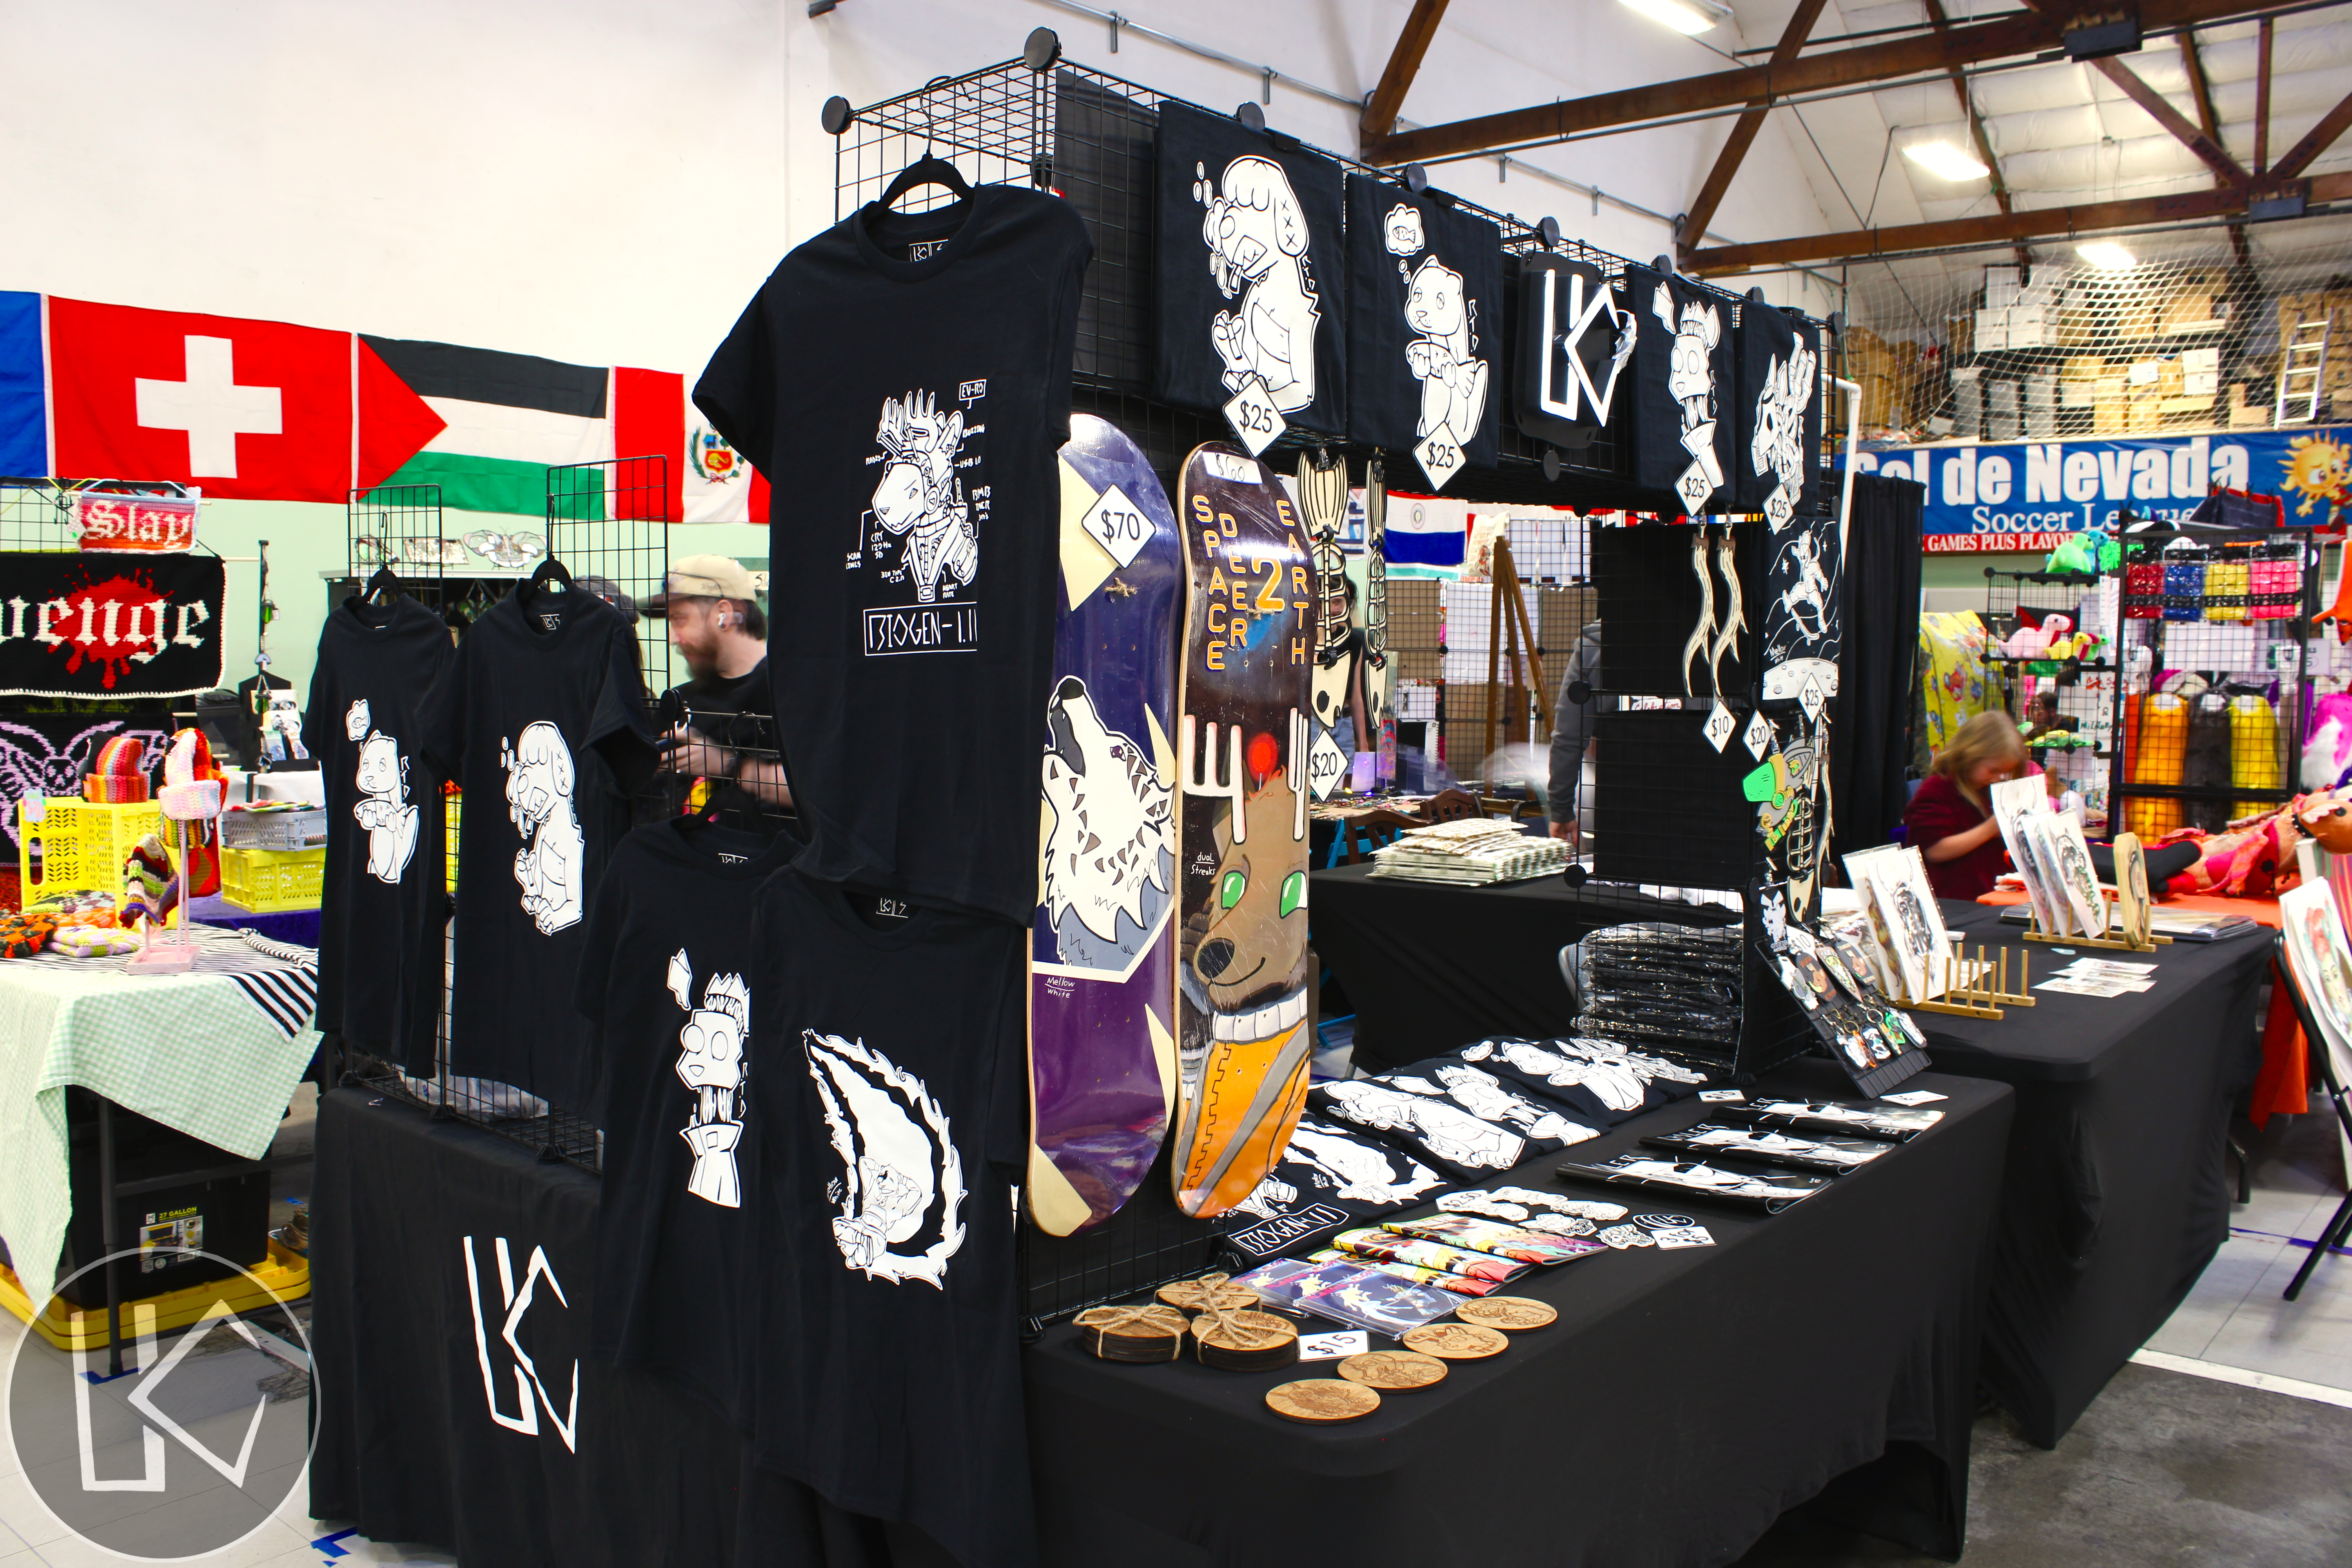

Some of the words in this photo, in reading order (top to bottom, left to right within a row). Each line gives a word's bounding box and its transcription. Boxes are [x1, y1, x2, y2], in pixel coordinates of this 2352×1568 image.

[1239, 400, 1272, 433] $25
[1215, 452, 1245, 482] $60
[1426, 444, 1455, 470] $25
[1942, 448, 2012, 506] de
[2026, 437, 2249, 503] Nevada
[1684, 477, 1705, 500] $25
[1769, 500, 1788, 520] $25
[1972, 506, 2074, 534] Soccer
[83, 500, 191, 549] Slay
[1101, 510, 1140, 544] $70
[1927, 534, 1977, 552] GAMES
[1981, 533, 2016, 550] PLUS
[942, 583, 958, 592] HEART
[1250, 557, 1285, 613] 2
[1805, 688, 1820, 708] $25
[1711, 715, 1729, 738] $10
[1750, 726, 1766, 745] $20
[1311, 751, 1338, 783] $20
[1191, 864, 1216, 875] Streaks
[1047, 976, 1075, 987] Mellow
[1706, 1091, 1735, 1100] $15
[1443, 1192, 1482, 1207] $2.50
[169, 1206, 197, 1216] GALLON
[1307, 1334, 1357, 1355] $15
